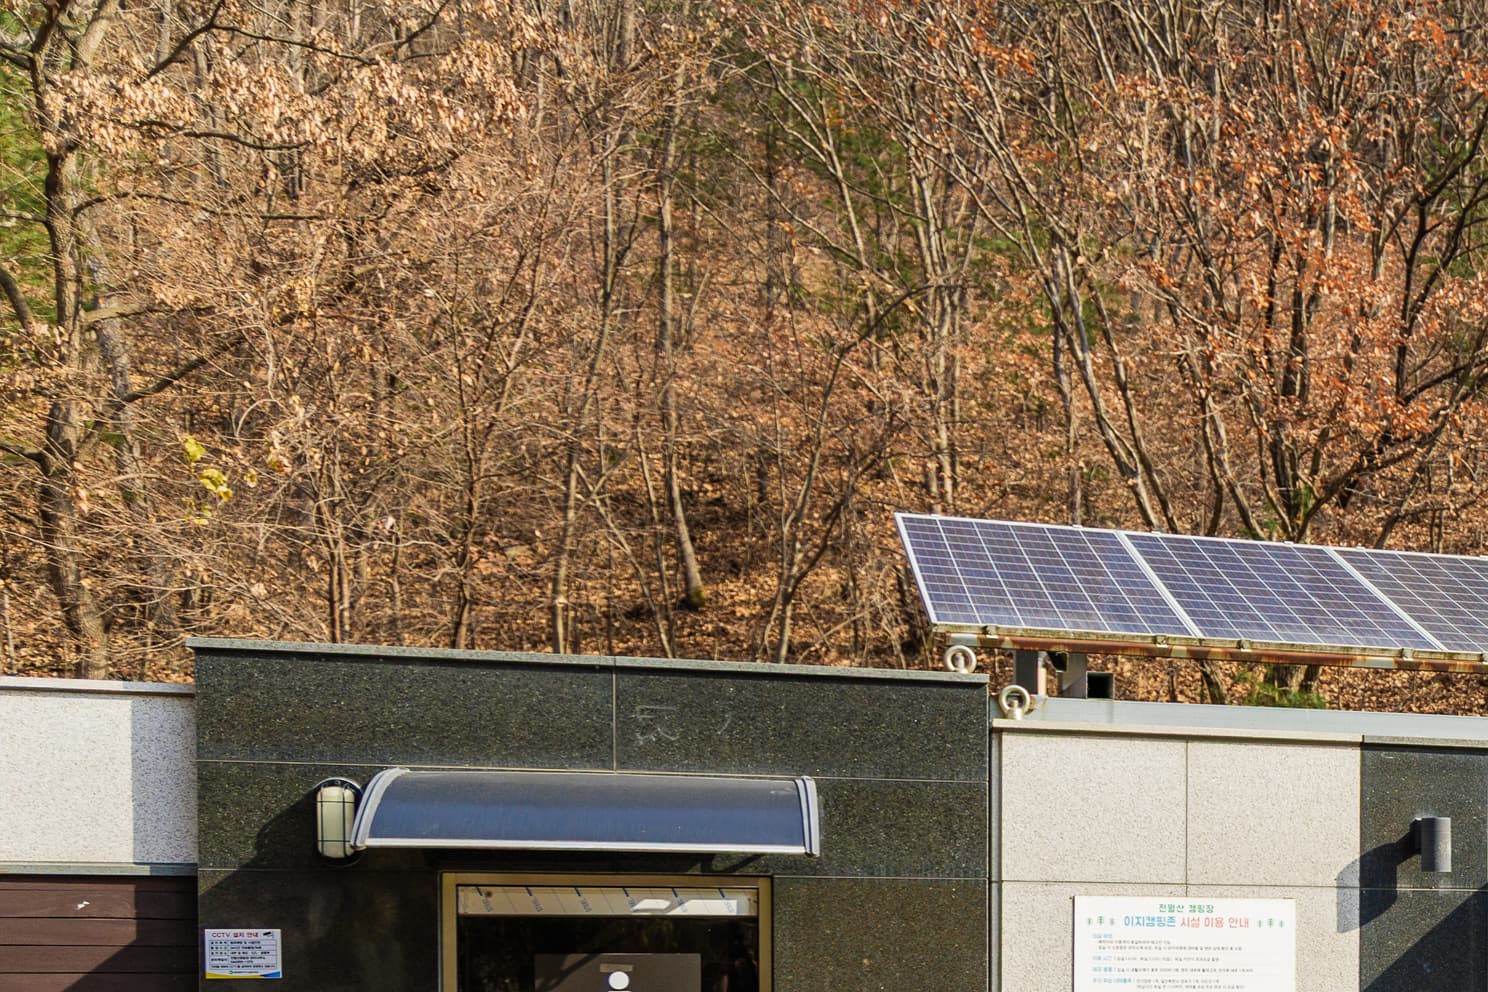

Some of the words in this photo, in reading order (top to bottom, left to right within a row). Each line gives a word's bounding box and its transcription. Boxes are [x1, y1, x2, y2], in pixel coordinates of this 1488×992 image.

[1158, 903, 1185, 913] 전월산
[1188, 904, 1214, 914] 캠핑장
[1123, 915, 1177, 928] 이지캠핑존
[1180, 917, 1200, 928] 시설
[1204, 917, 1225, 928] 이용
[1228, 917, 1249, 928] 안내
